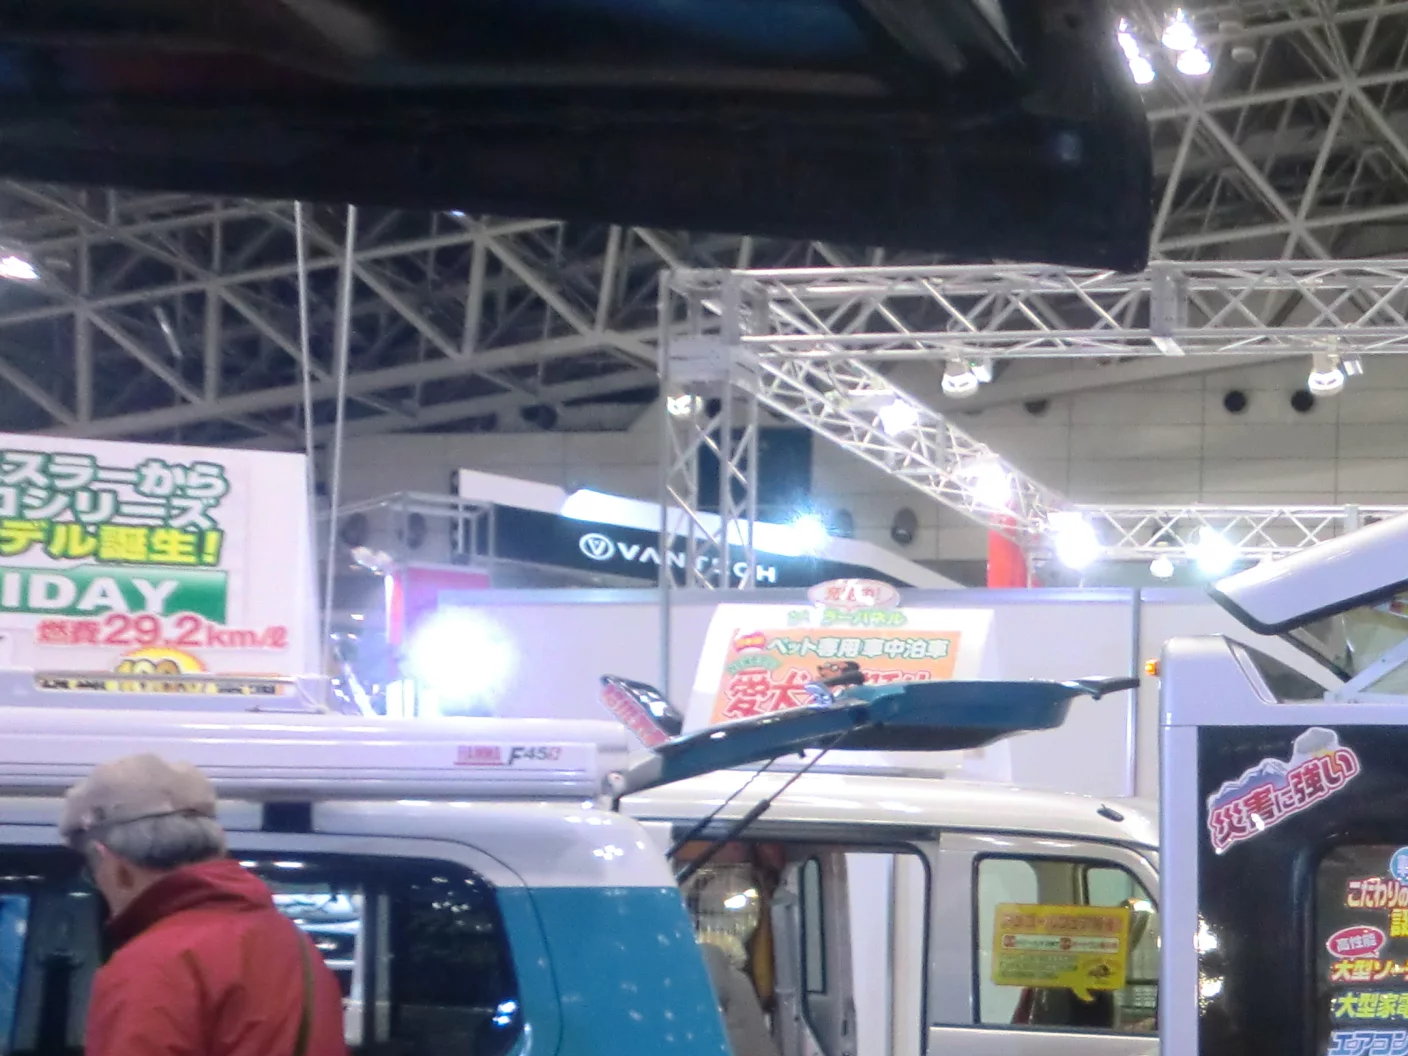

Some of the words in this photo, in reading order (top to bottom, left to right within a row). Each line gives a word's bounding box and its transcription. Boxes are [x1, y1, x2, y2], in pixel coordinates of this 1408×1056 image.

[1210, 749, 1358, 849] 災害に強い
